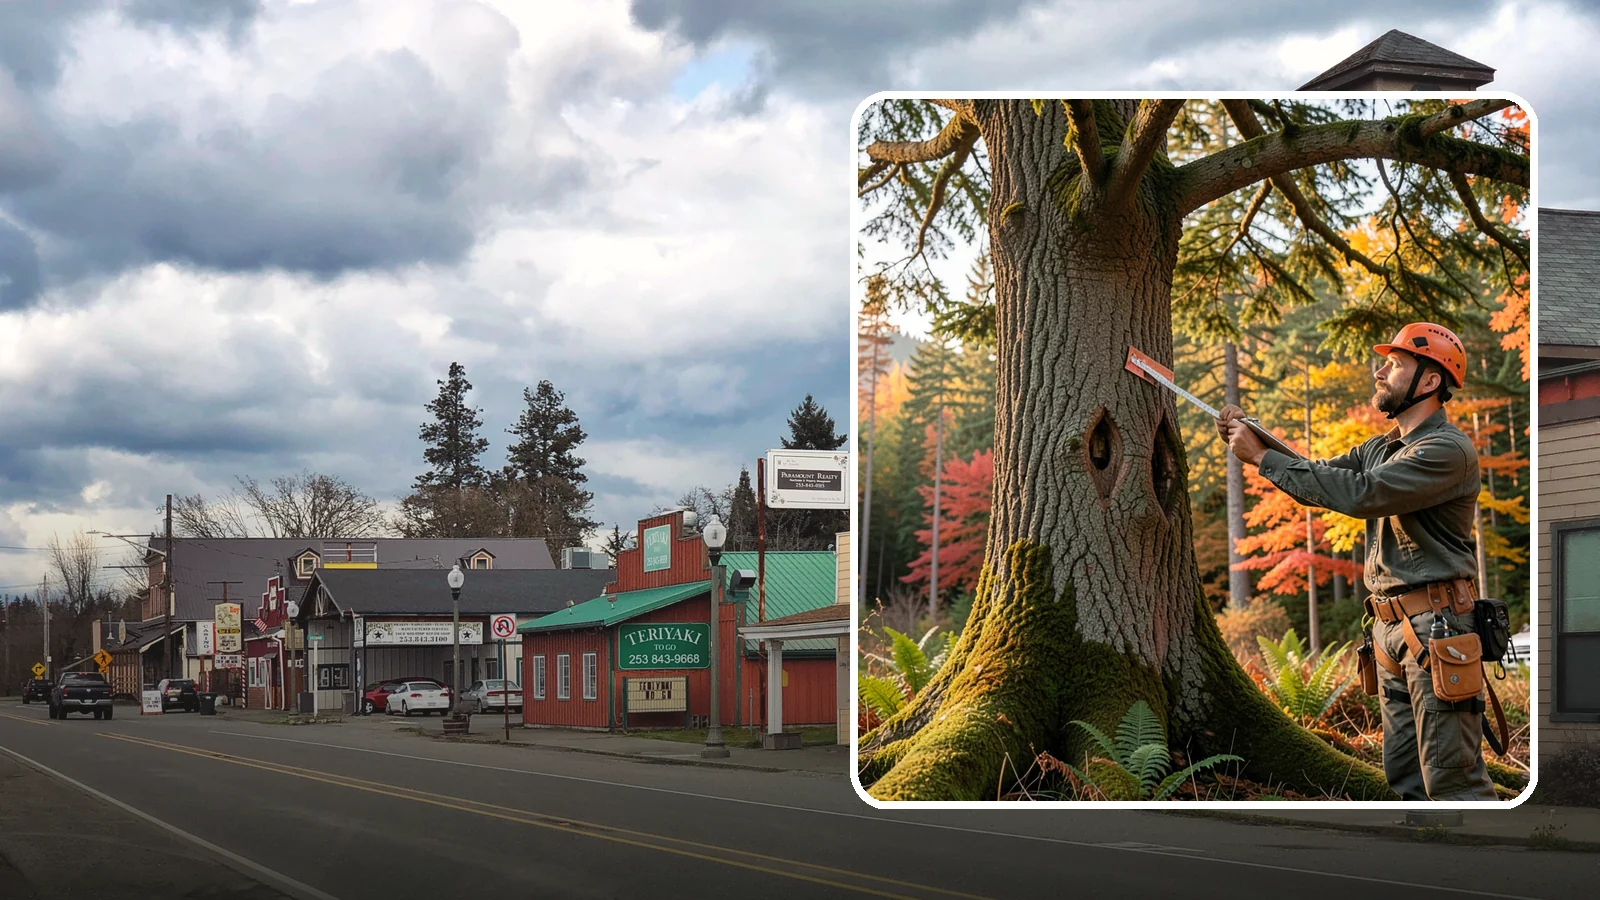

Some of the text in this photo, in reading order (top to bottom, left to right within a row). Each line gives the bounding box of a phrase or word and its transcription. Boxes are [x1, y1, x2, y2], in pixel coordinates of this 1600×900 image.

[781, 471, 839, 480] PARAMOUNT REALTY
[625, 627, 702, 646] TERIYAKI
[665, 643, 677, 651] GO
[629, 653, 700, 664] 253 843-9668
[639, 681, 673, 690] TERIYAKI
